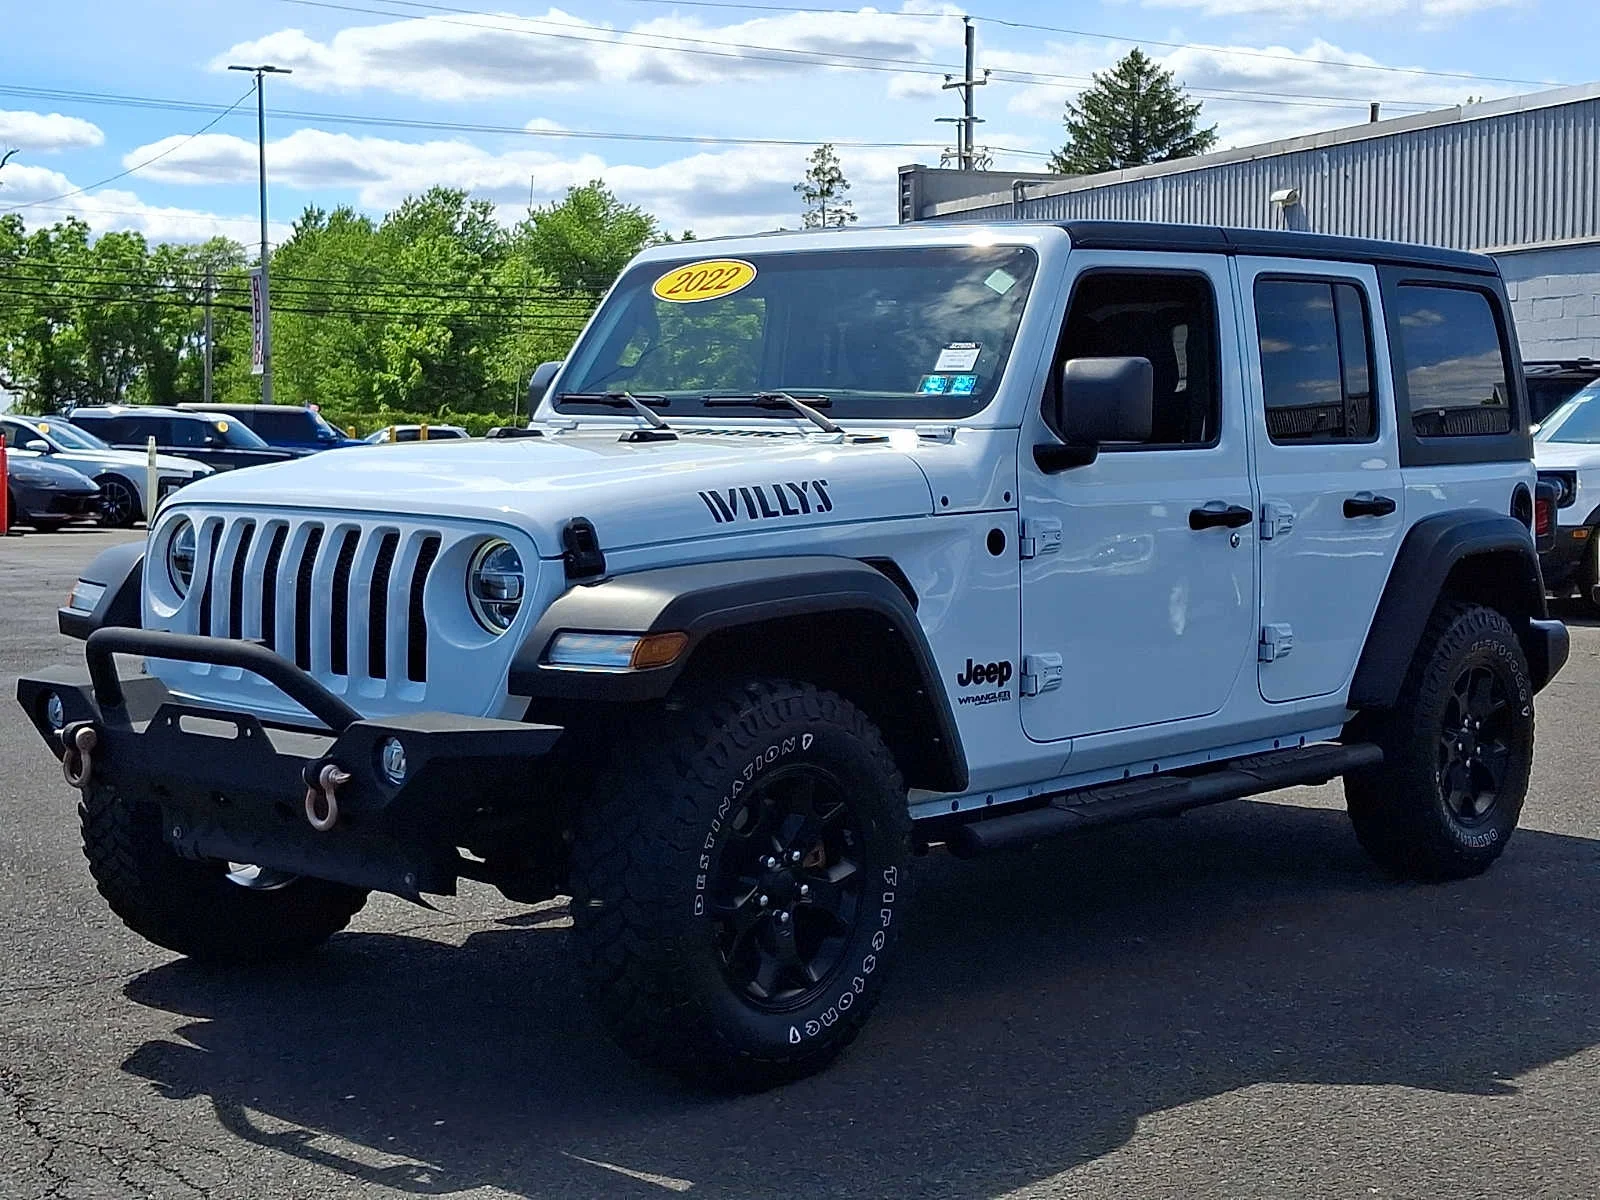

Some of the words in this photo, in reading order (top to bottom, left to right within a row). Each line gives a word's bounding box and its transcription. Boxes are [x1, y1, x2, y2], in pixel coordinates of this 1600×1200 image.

[665, 266, 742, 295] 2022
[697, 479, 833, 523] WILLYS
[956, 658, 1013, 688] Jeep
[957, 690, 1012, 705] WRANGLER
[693, 736, 797, 916] DESTINATION
